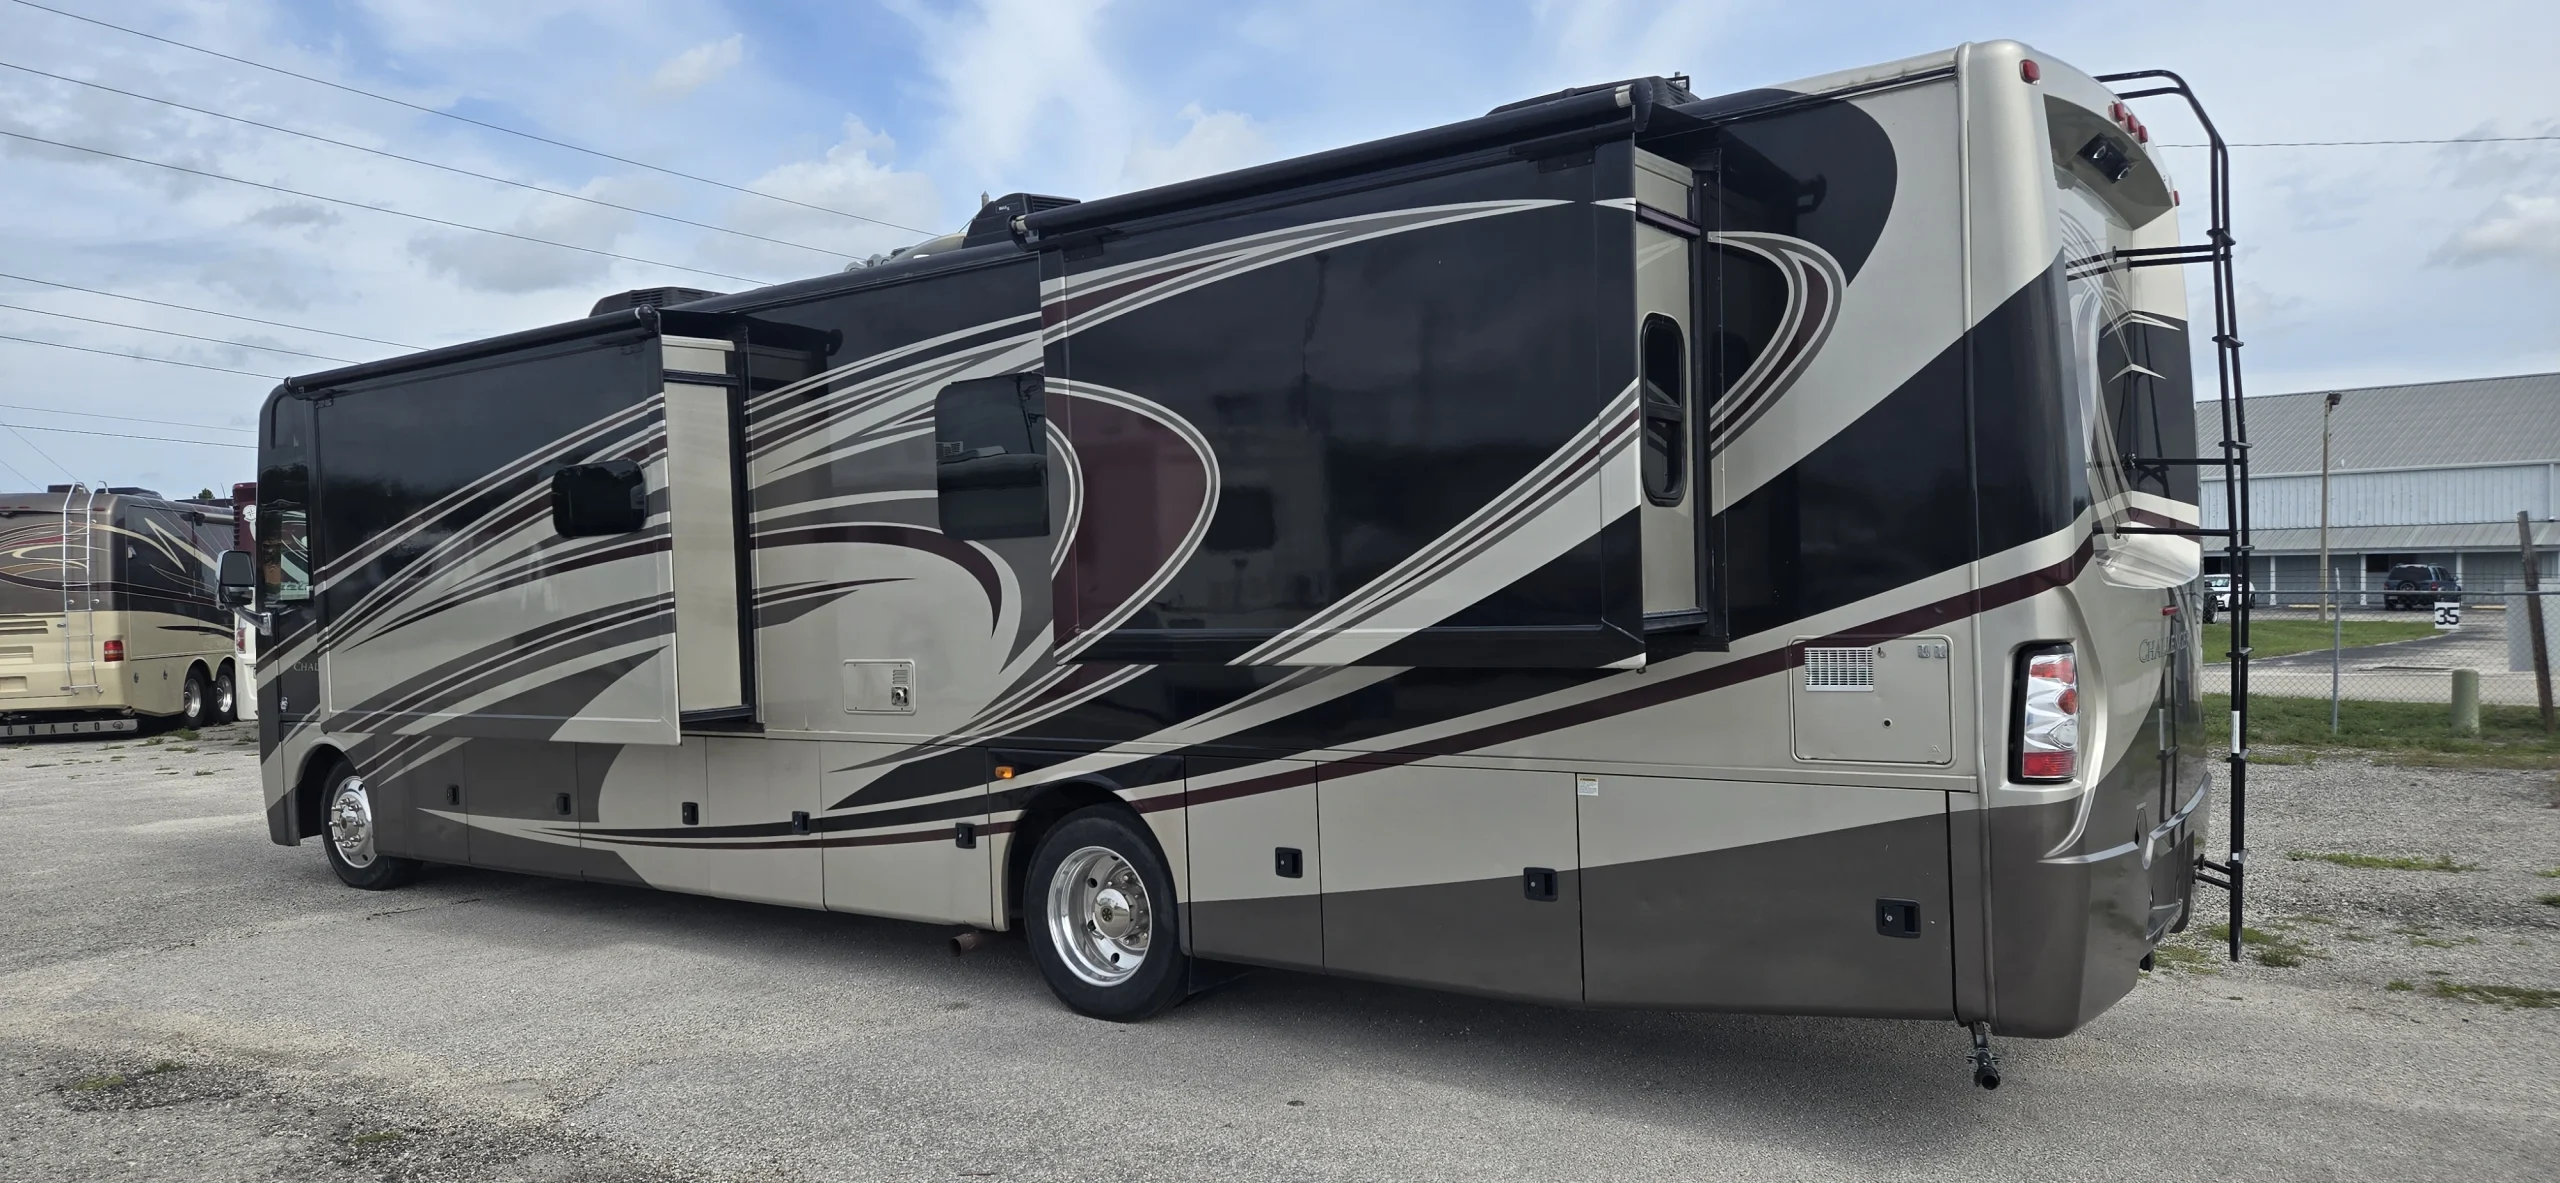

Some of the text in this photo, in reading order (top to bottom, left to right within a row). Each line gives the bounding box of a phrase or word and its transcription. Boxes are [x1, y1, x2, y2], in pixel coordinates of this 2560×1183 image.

[2435, 606, 2459, 626] 35
[293, 661, 319, 672] CHAL
[6, 721, 101, 736] ONACO
